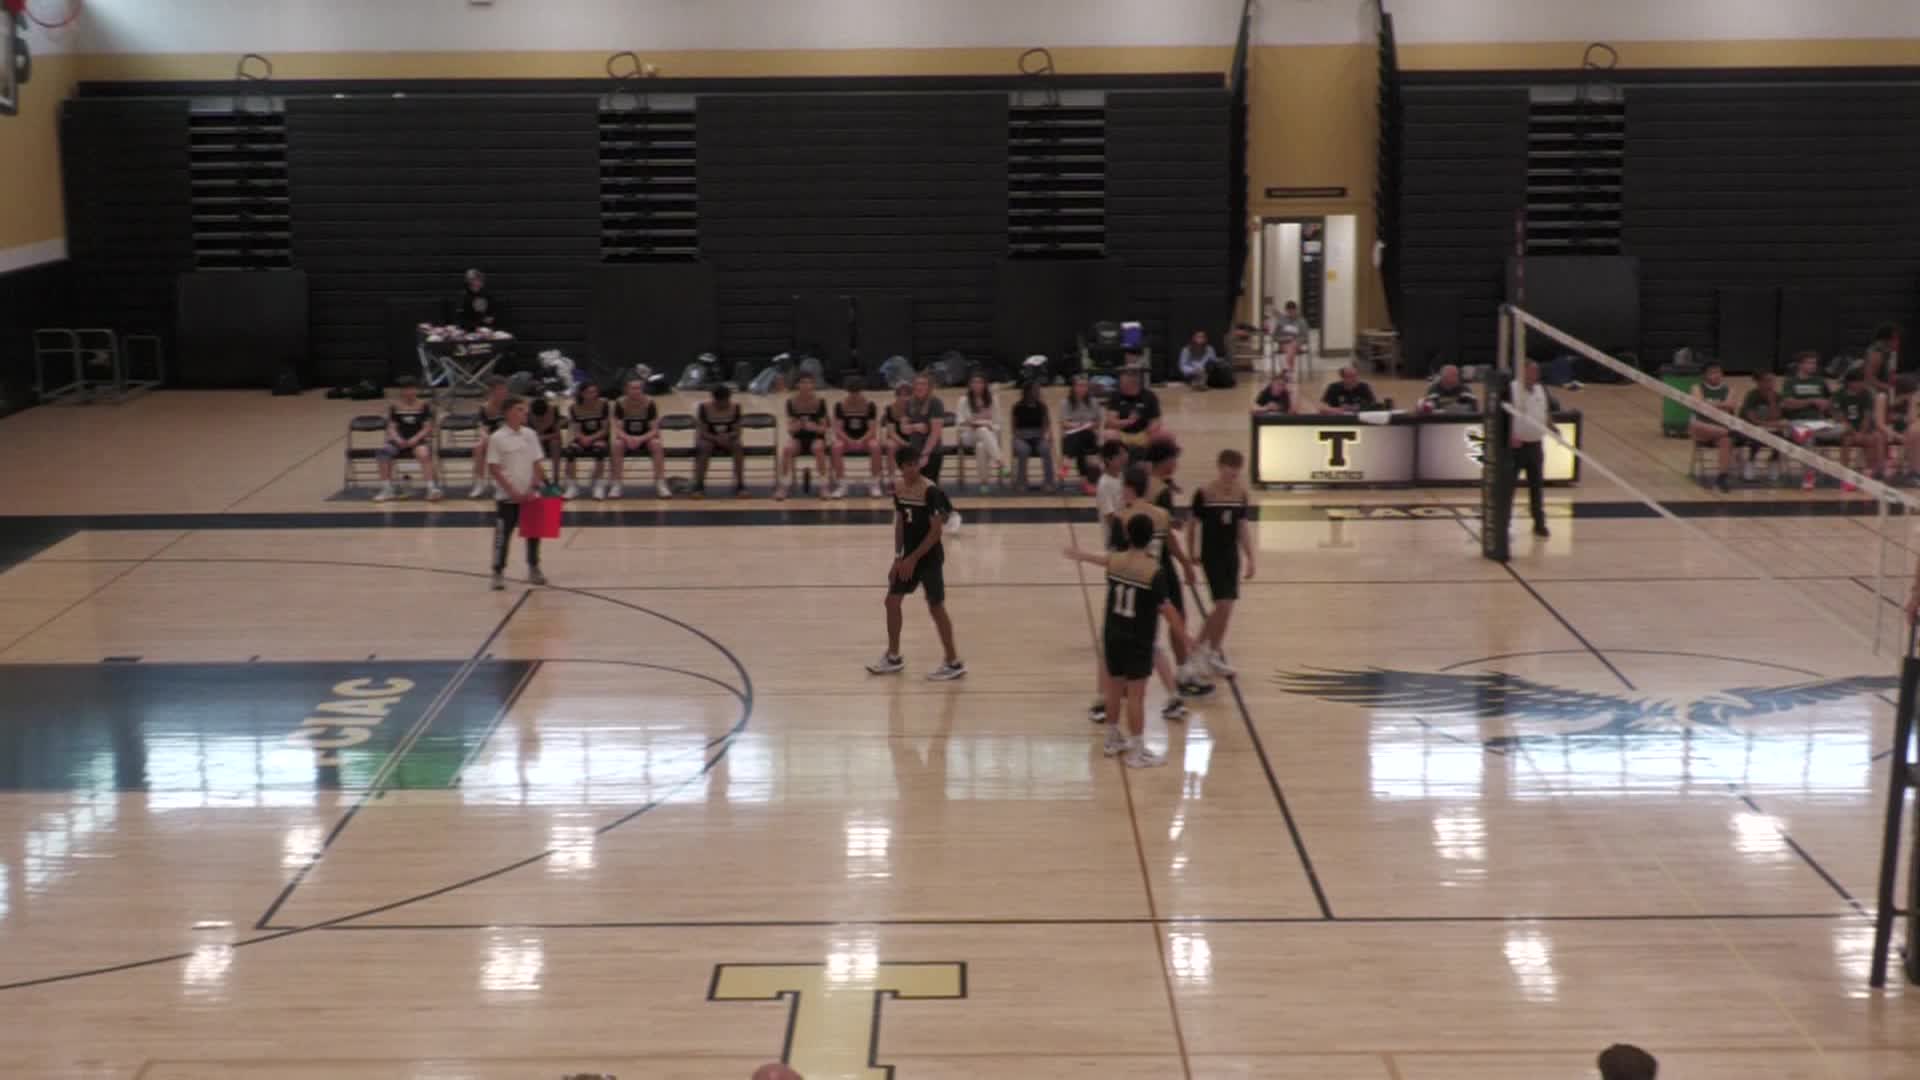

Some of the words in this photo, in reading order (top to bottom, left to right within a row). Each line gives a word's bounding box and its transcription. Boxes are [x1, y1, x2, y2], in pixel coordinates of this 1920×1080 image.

[1318, 430, 1358, 468] T
[1112, 583, 1137, 618] 11
[707, 960, 968, 1080] T
